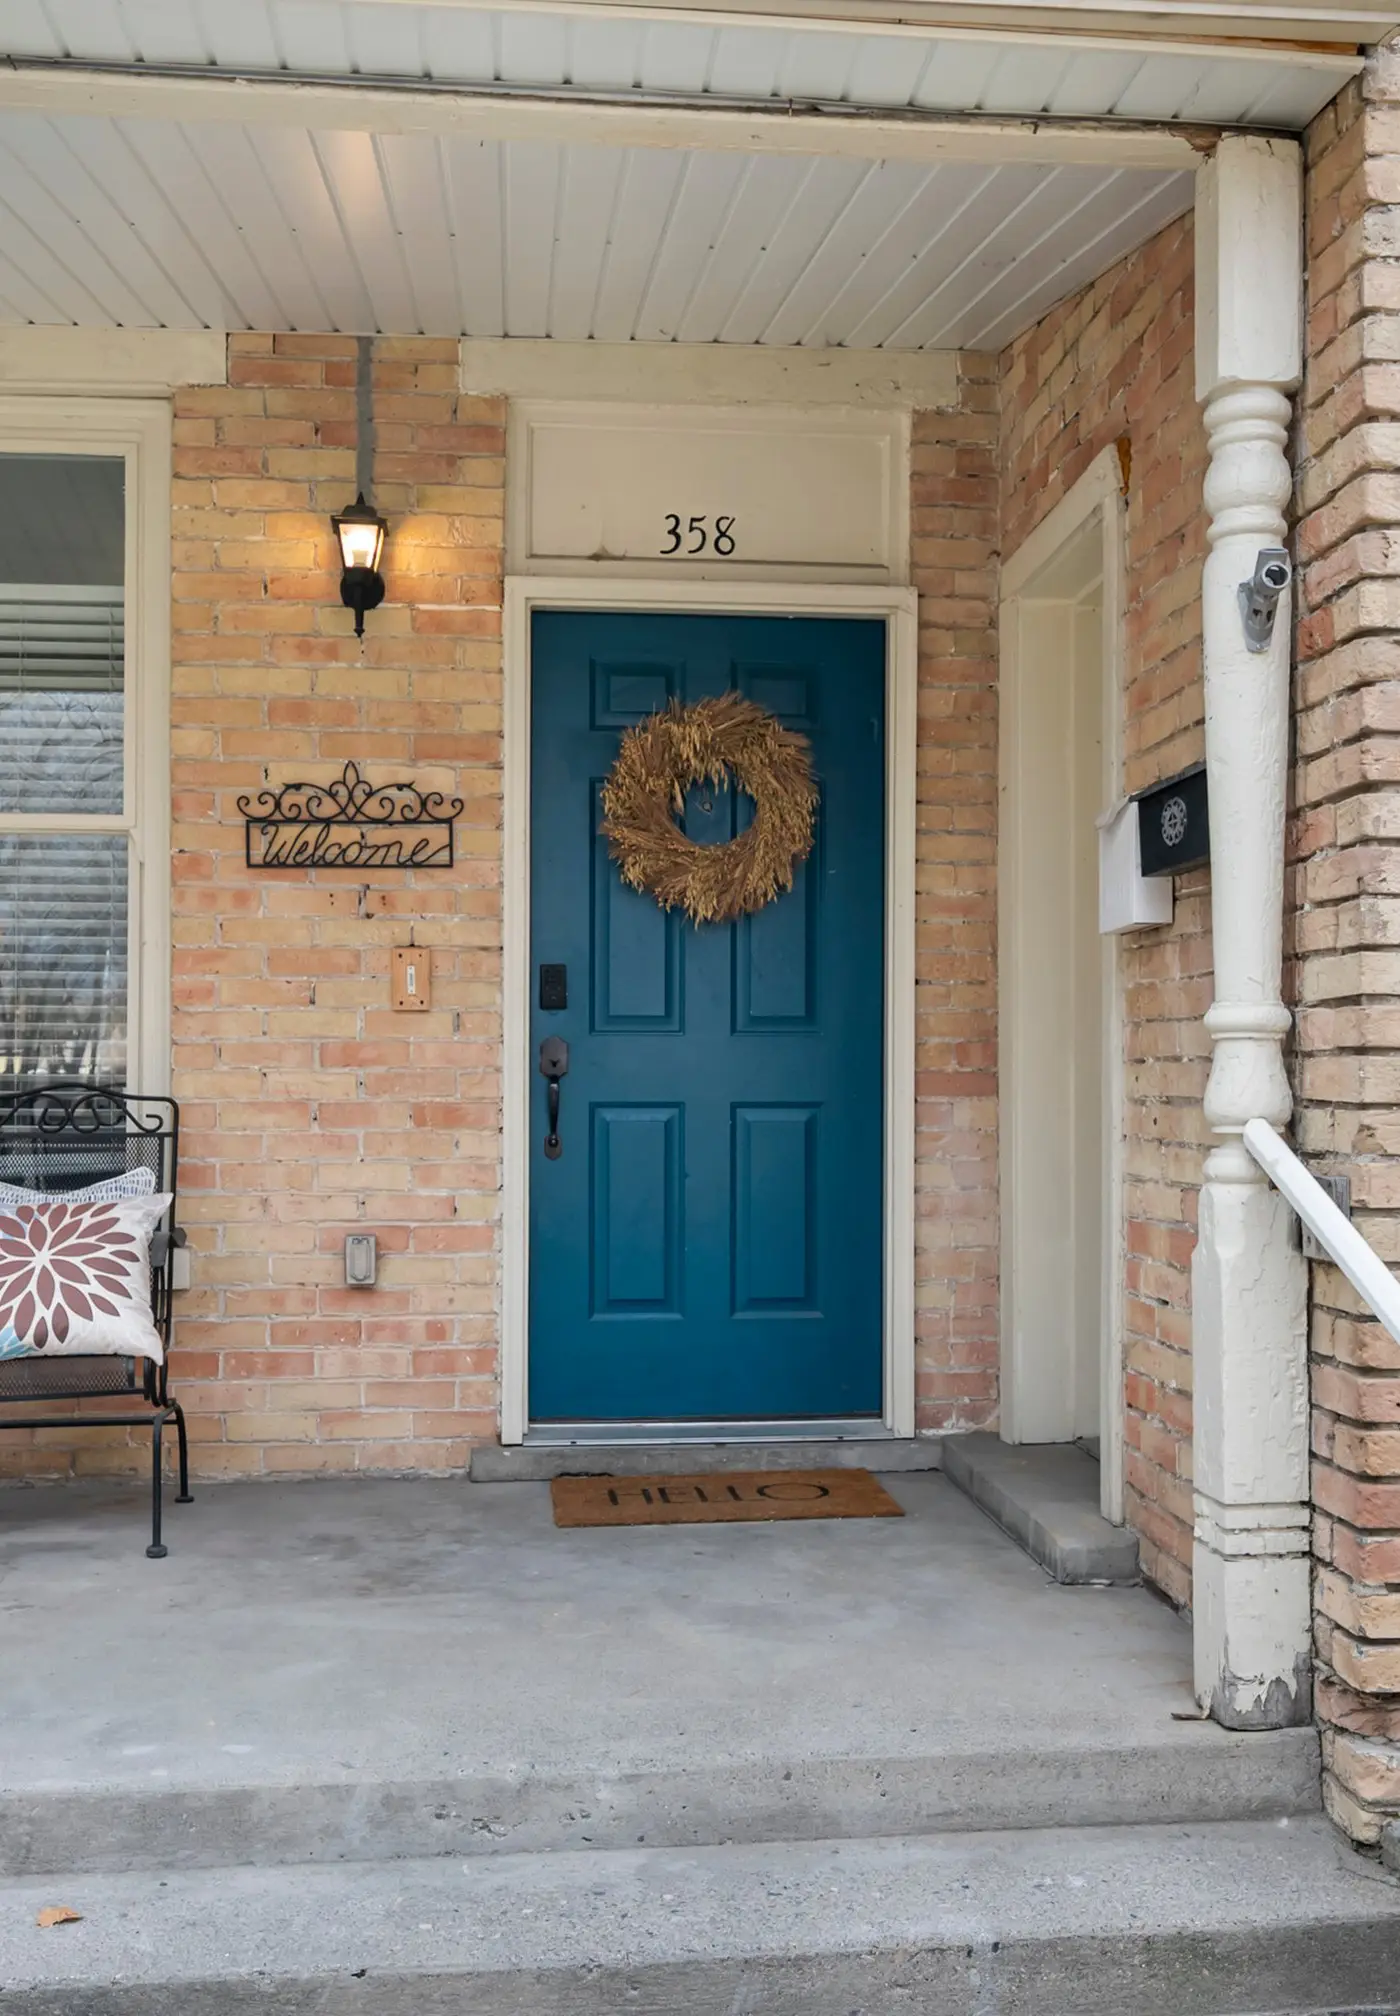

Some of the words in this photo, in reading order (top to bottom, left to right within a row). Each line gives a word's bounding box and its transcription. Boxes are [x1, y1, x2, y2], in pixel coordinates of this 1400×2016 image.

[660, 513, 736, 556] 358
[260, 822, 449, 864] Welcome
[606, 1482, 830, 1506] HELLO
